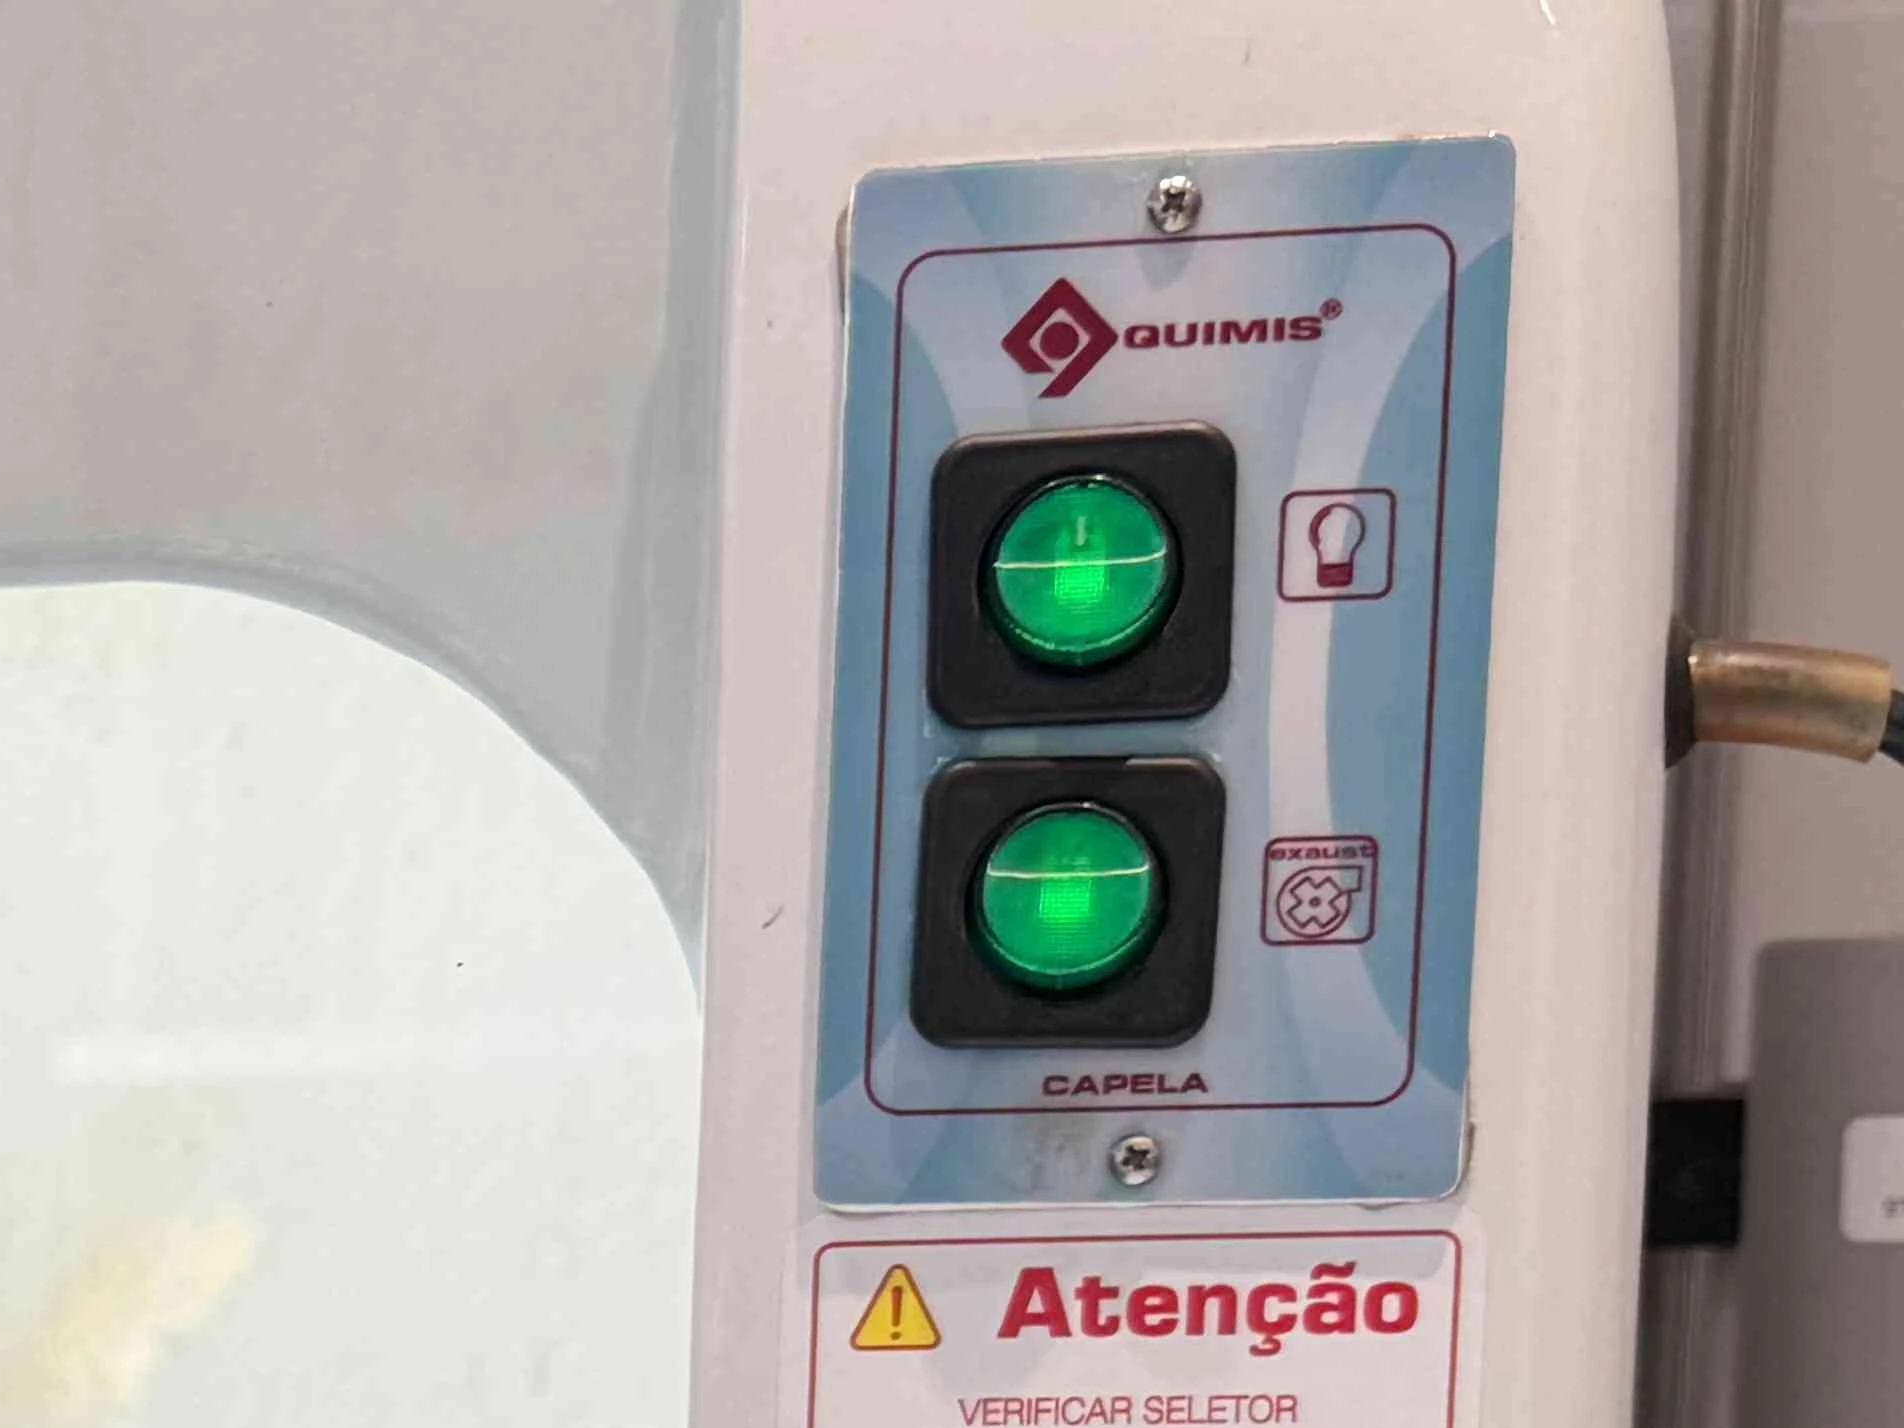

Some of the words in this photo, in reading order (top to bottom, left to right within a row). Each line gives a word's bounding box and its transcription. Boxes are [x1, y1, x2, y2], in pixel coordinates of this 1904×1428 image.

[1042, 1072, 1209, 1096] CAPELA
[996, 1261, 1419, 1357] Atenção
[957, 1396, 1133, 1426] VERIFICAR
[1143, 1394, 1298, 1424] SELETOR
